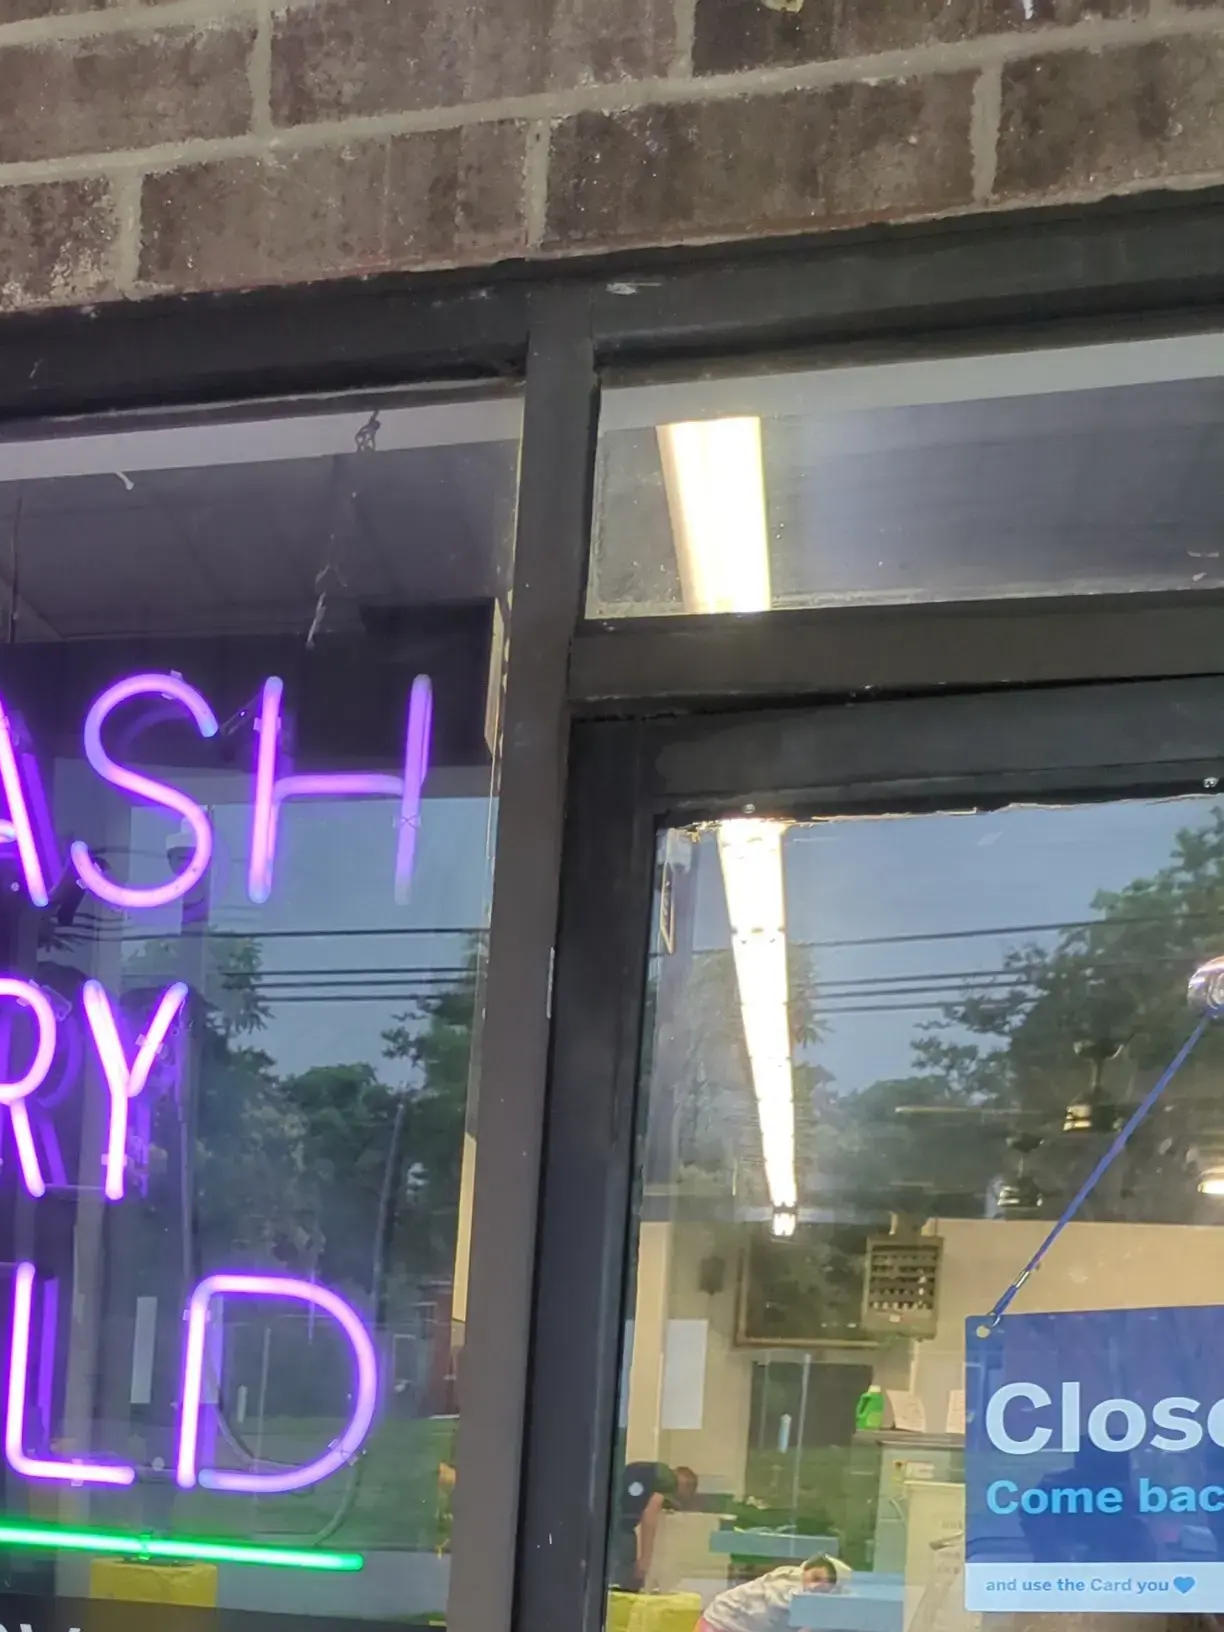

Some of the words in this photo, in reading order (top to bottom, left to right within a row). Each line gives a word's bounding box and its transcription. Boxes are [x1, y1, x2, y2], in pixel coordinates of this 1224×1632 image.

[986, 1479, 1123, 1515] Come
[986, 1578, 1017, 1592] and
[1022, 1580, 1052, 1592] use
[1057, 1578, 1085, 1592] the
[1090, 1578, 1132, 1592] Card
[1137, 1581, 1169, 1595] you
